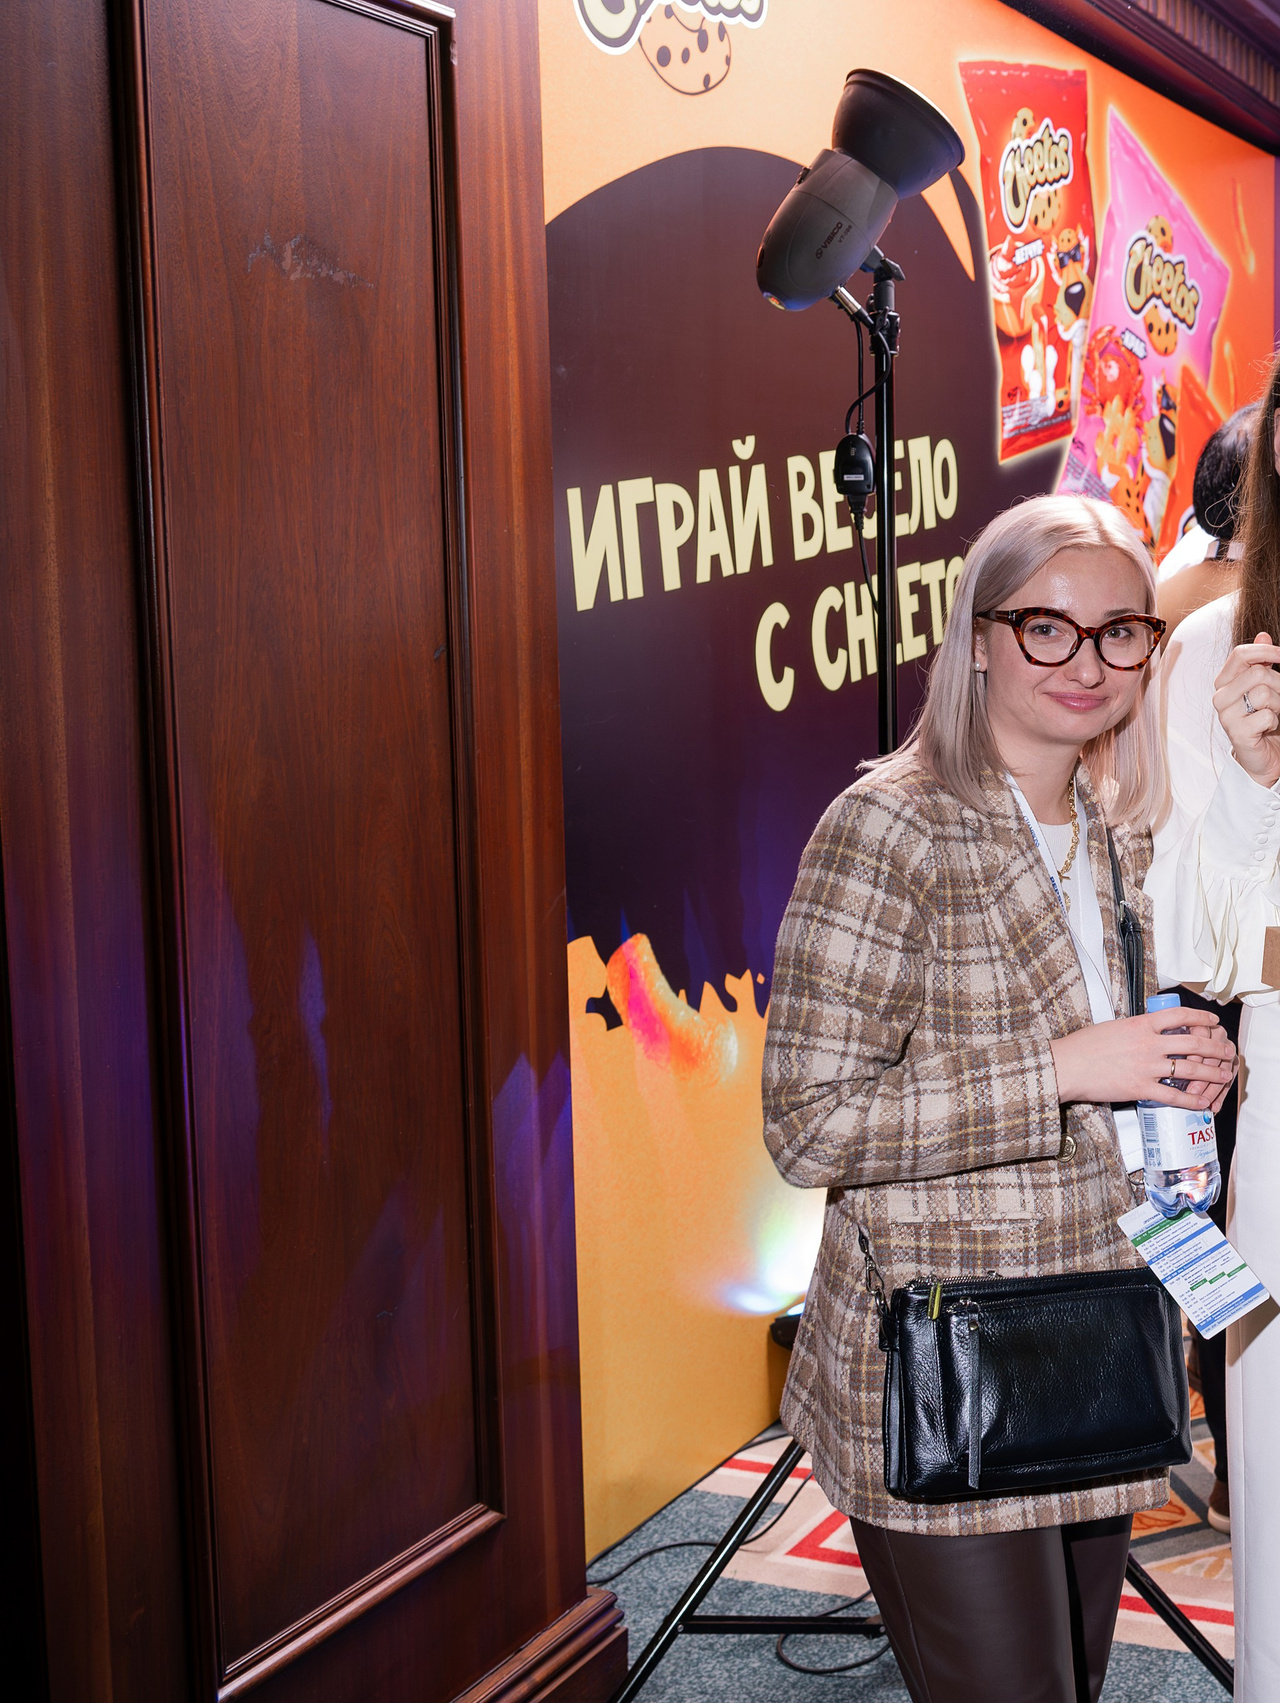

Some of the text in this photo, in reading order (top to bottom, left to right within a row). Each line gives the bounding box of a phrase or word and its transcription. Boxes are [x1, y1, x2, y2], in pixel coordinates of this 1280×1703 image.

[1002, 123, 1071, 228] Cheetos
[821, 221, 843, 249] VISICO
[1126, 236, 1200, 330] Cheetos
[566, 435, 959, 612] ИГРАЙ ВЕЕЛО
[811, 556, 964, 692] CHET
